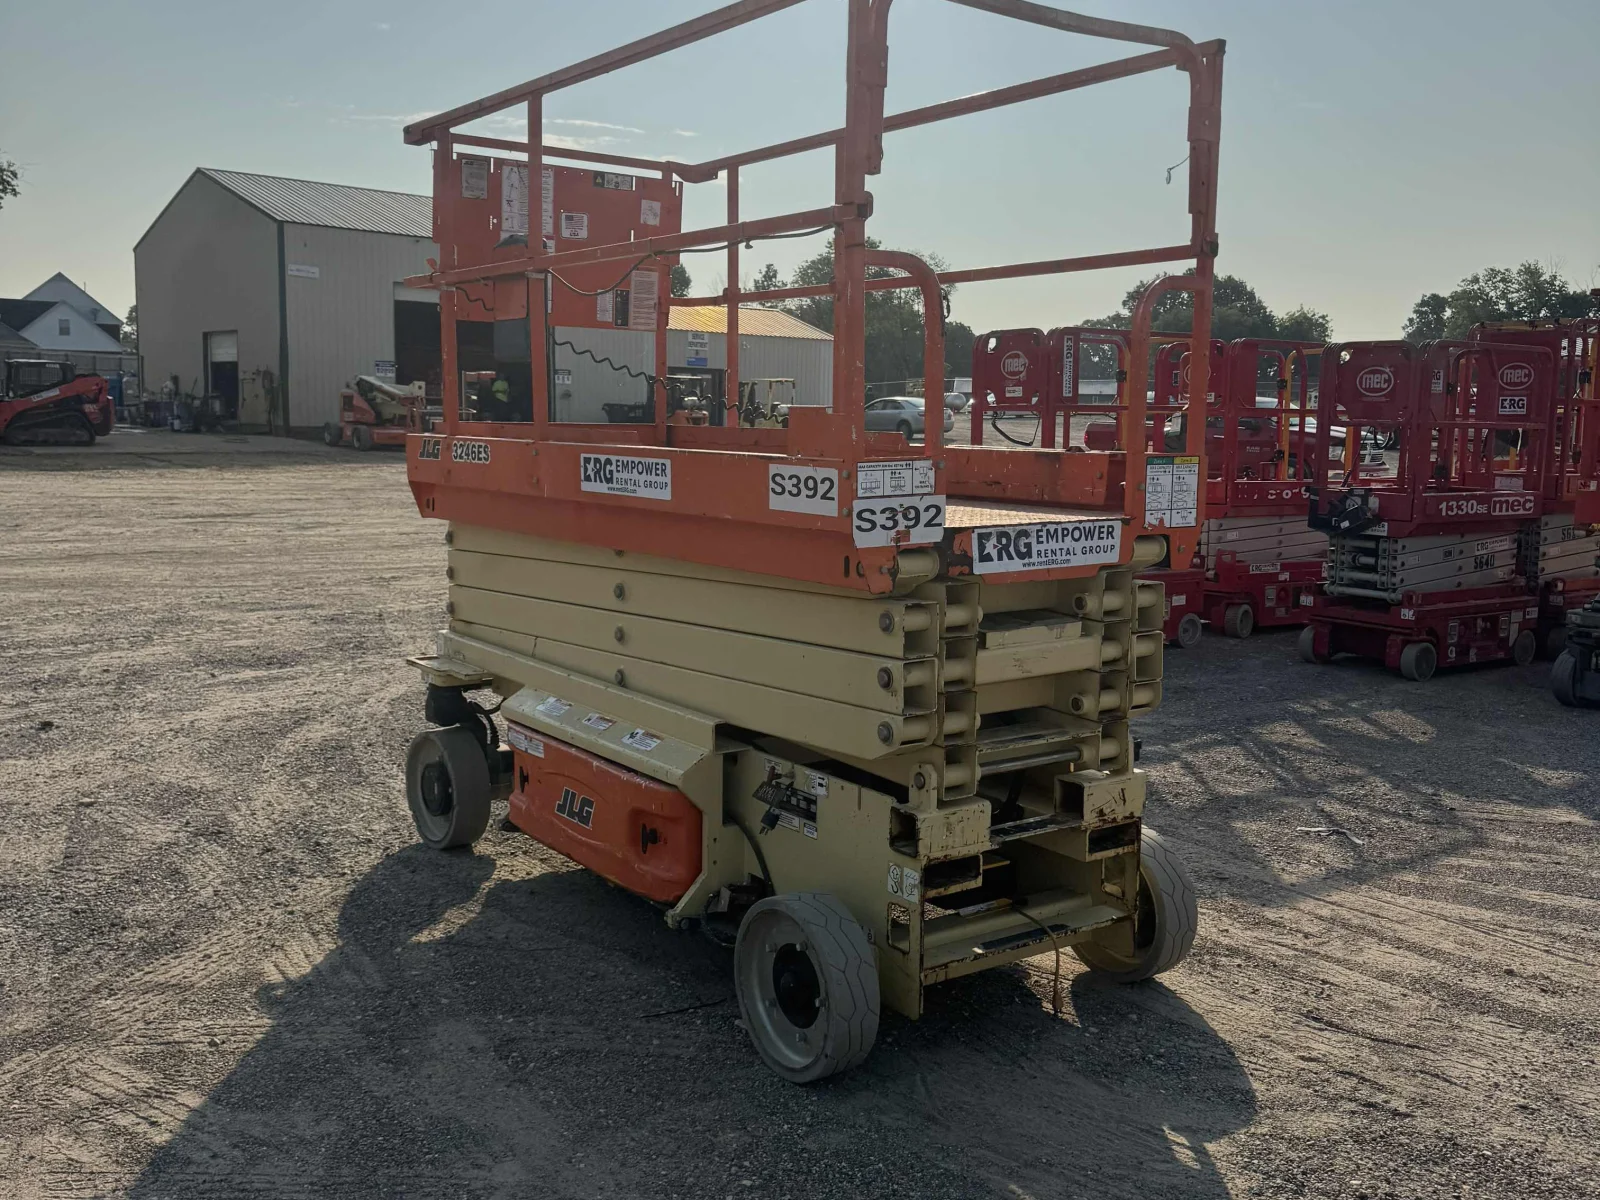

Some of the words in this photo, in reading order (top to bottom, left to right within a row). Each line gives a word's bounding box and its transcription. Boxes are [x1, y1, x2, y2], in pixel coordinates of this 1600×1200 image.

[1500, 398, 1526, 410] ERG
[418, 438, 441, 460] JLG
[453, 441, 490, 464] 3246ES
[583, 456, 614, 485] ERG
[615, 459, 668, 478] EMPOWER
[615, 477, 641, 488] RENTAL
[643, 479, 669, 490] GROUP
[770, 472, 836, 501] S392
[855, 504, 943, 533] S392
[977, 528, 1033, 563] ERG
[1035, 524, 1116, 545] EMPOWER
[1036, 548, 1077, 559] RENTAL
[1081, 544, 1116, 556] GROUP
[1476, 541, 1489, 552] ERG
[1022, 558, 1072, 568] www.rentERG.com
[1473, 554, 1495, 570] S640
[555, 786, 596, 830] JLG
